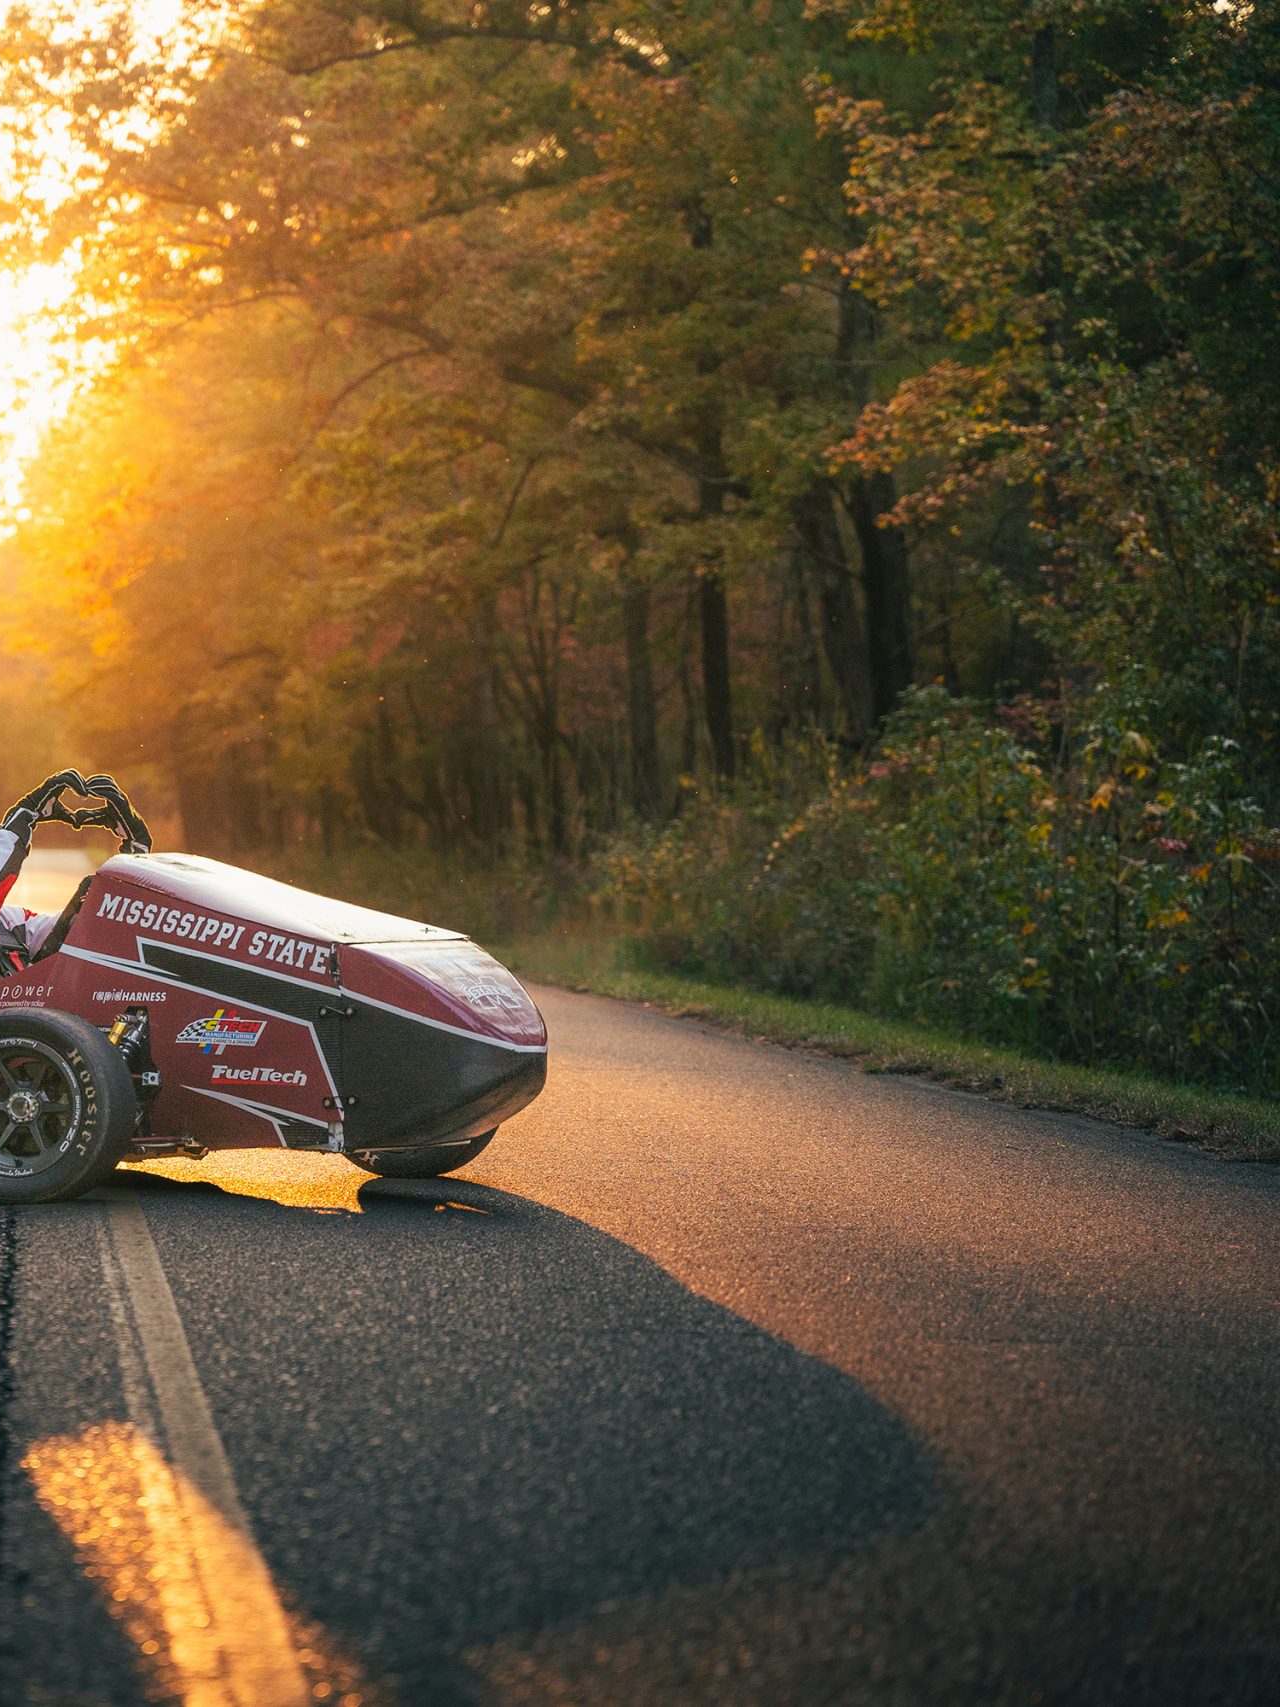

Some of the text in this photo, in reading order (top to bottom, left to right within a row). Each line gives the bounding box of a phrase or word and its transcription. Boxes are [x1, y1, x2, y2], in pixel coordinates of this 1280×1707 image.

[96, 892, 332, 975] MISSISSIPPI STATE
[205, 1031, 254, 1039] MANUFACTURING
[211, 1064, 308, 1086] FuelTech
[67, 1047, 98, 1157] Hoosier
[14, 1168, 34, 1177] Student
